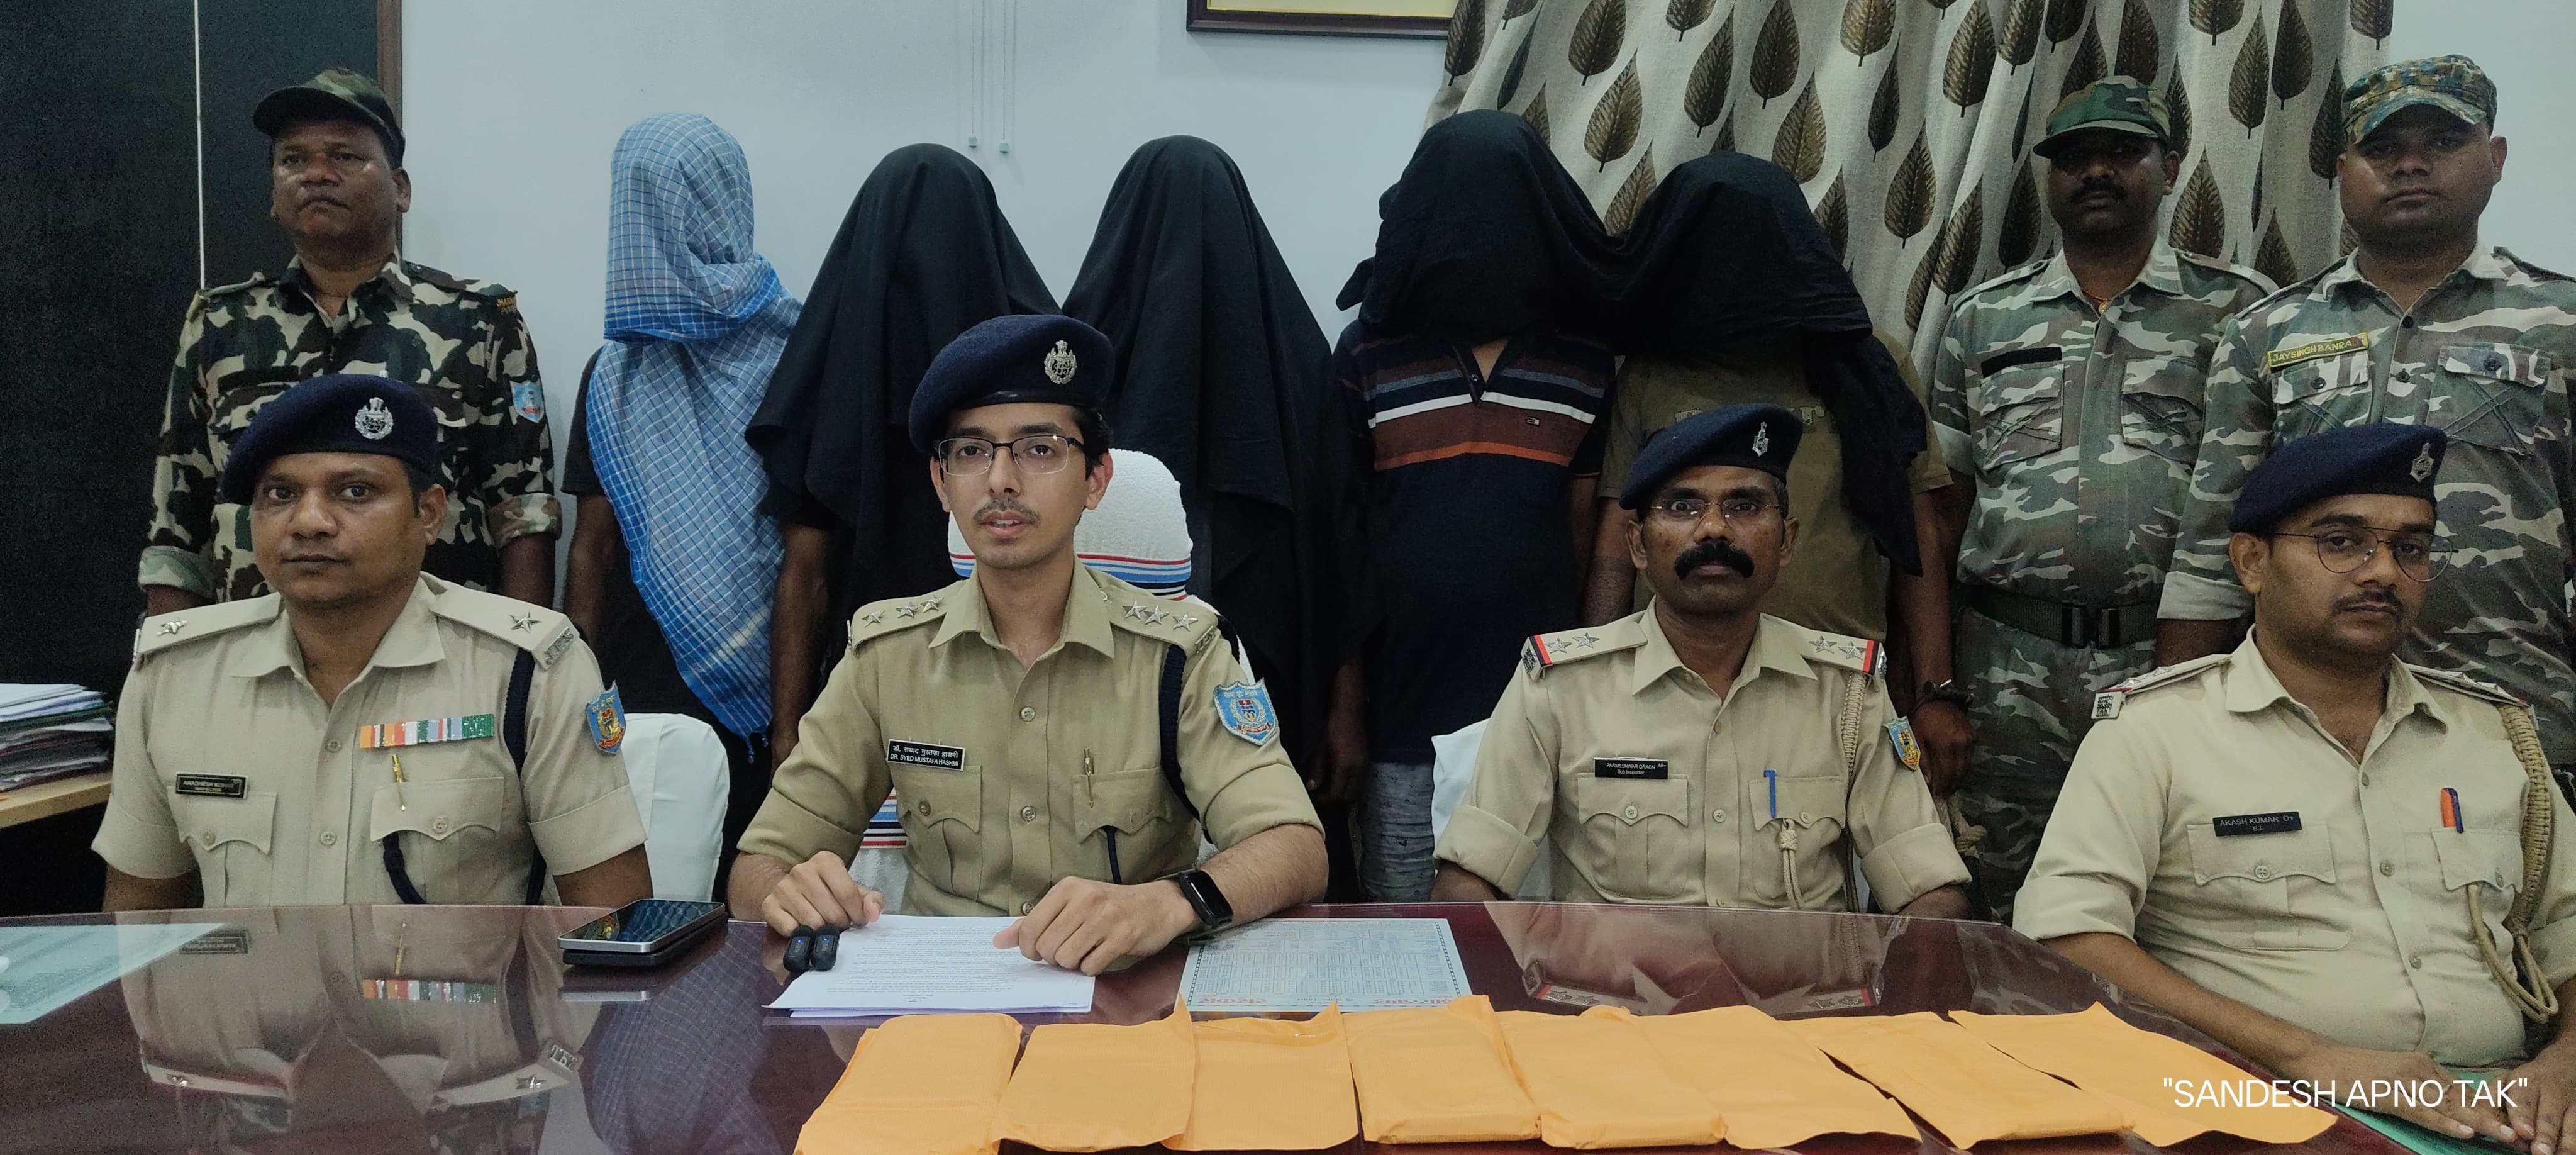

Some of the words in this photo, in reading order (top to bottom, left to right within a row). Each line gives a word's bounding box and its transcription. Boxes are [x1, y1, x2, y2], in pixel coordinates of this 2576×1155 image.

[2318, 340, 2352, 352] BANRA
[914, 756, 938, 764] MUSTAFA
[938, 759, 958, 767] HASHMI
[2219, 818, 2248, 827] AKASH
[2249, 816, 2279, 824] KUMAR
